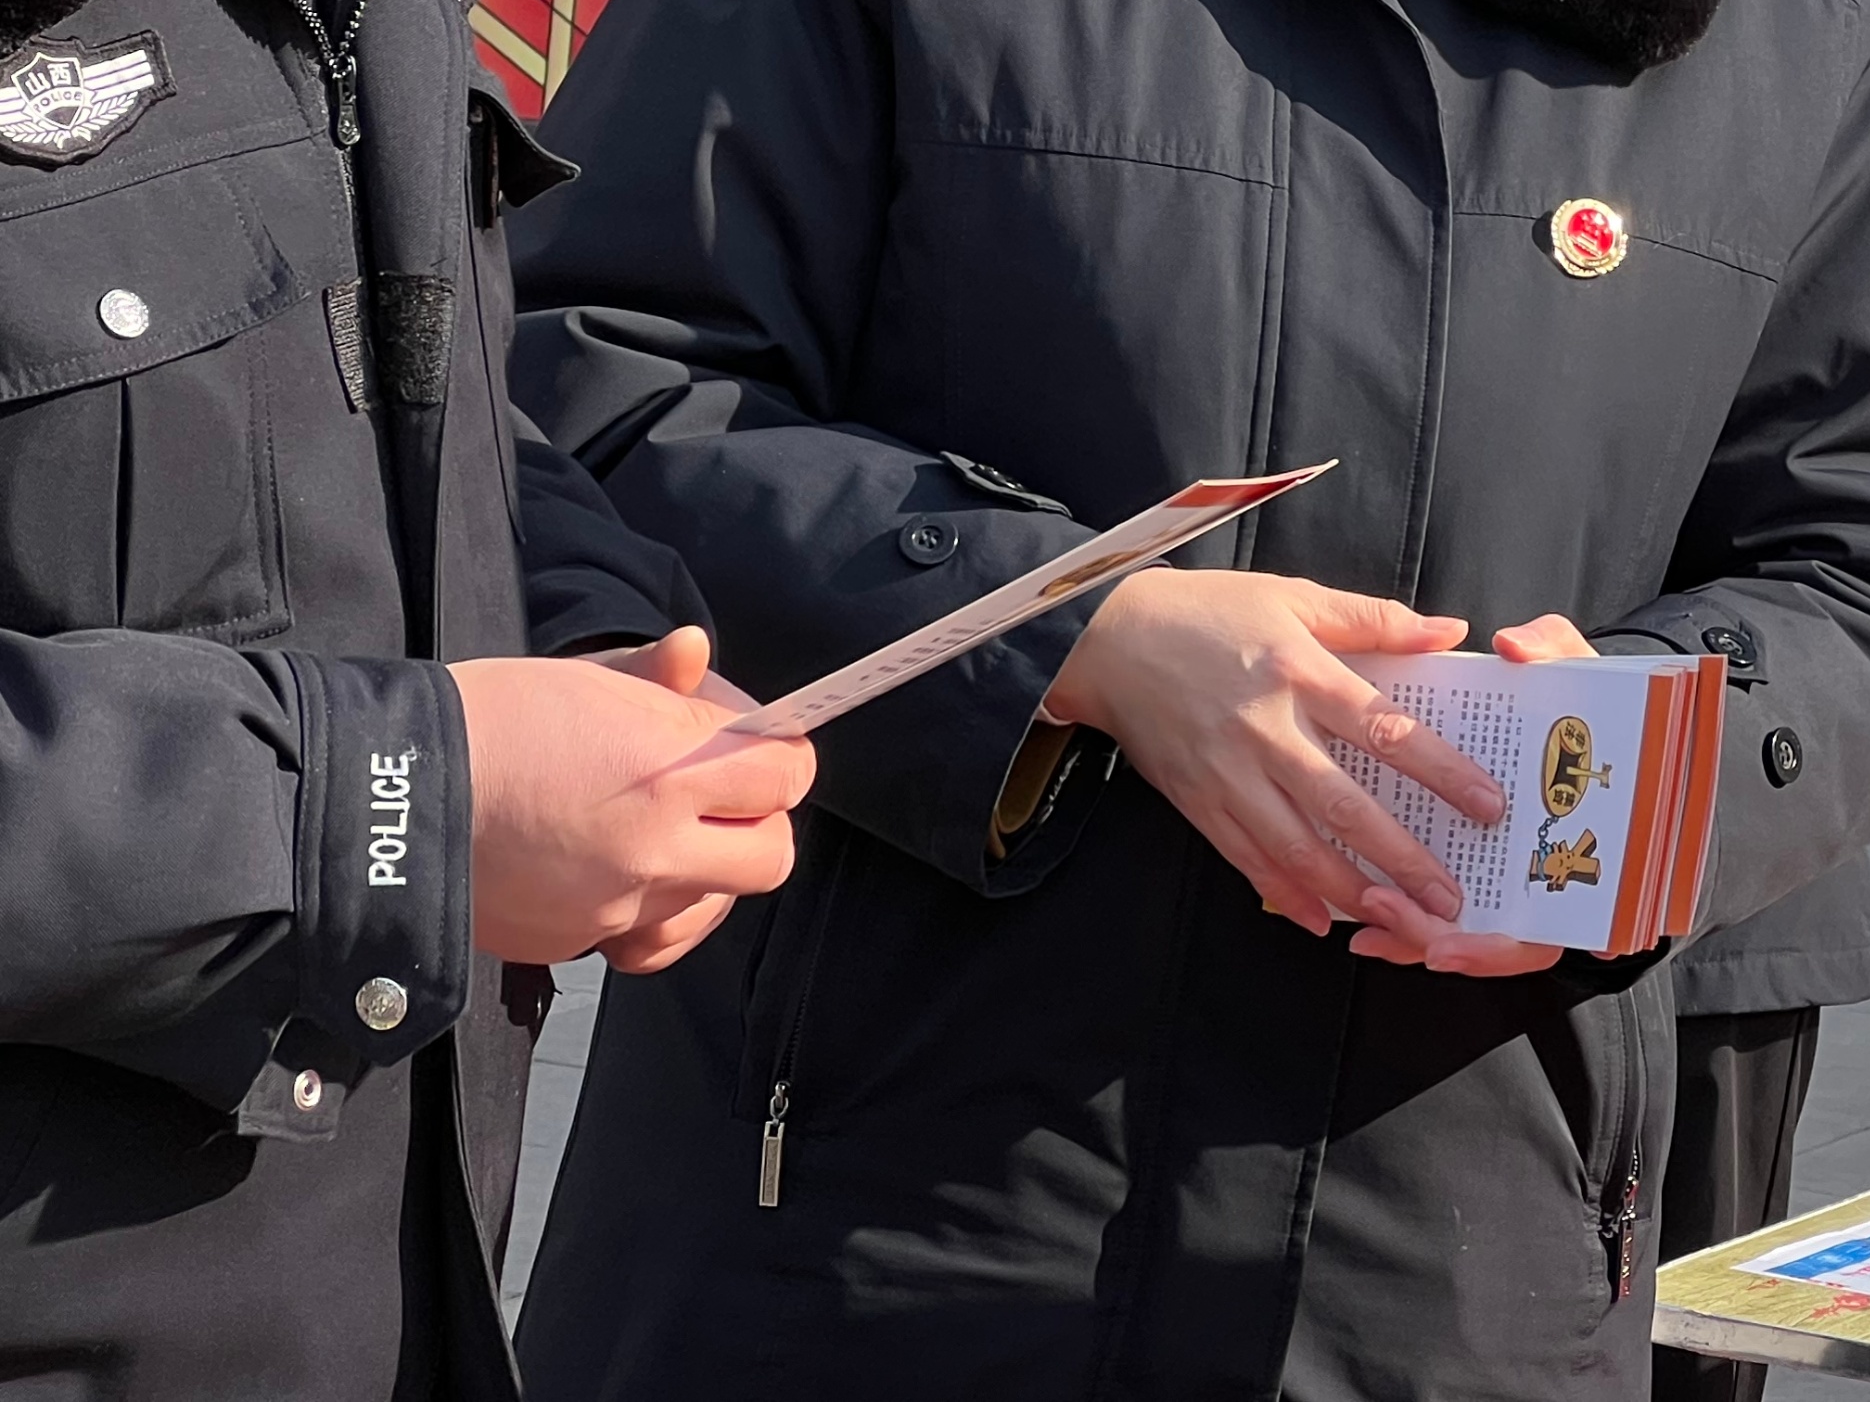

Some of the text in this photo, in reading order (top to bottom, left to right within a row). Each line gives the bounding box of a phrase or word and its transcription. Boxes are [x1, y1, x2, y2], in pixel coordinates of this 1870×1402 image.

[24, 62, 72, 96] 山西
[32, 90, 84, 114] POLICE
[367, 752, 411, 887] POLICE
